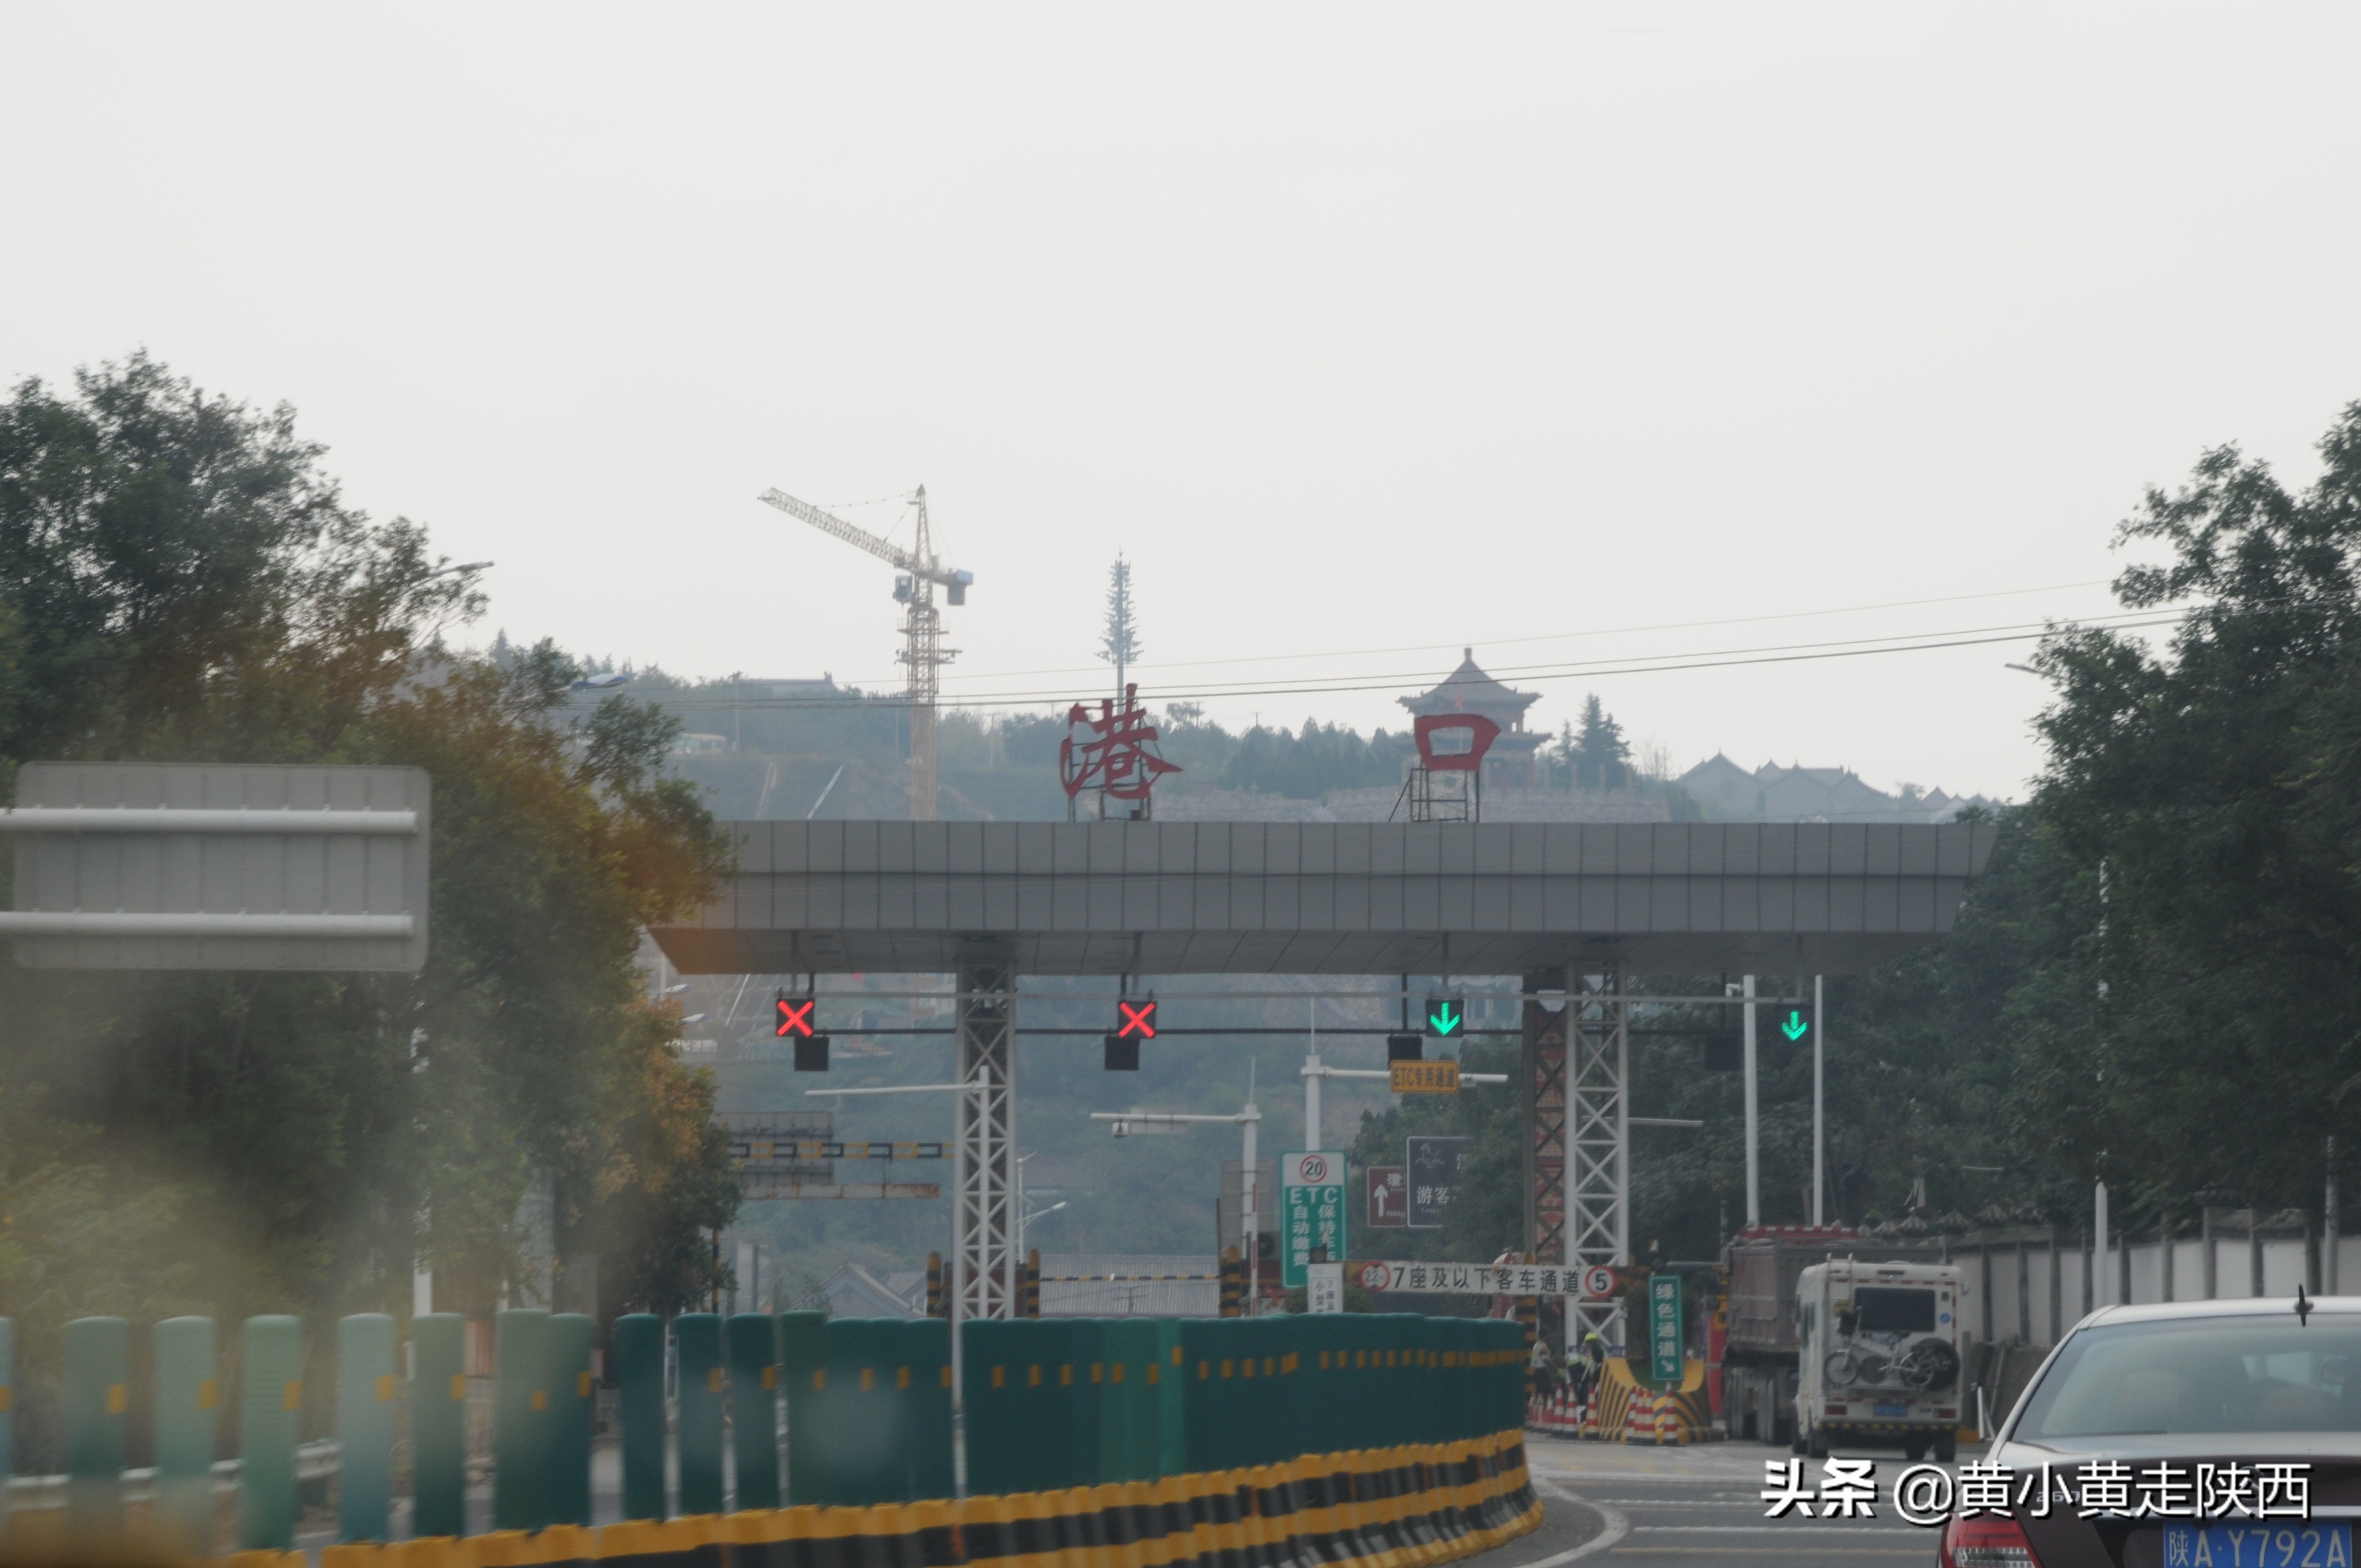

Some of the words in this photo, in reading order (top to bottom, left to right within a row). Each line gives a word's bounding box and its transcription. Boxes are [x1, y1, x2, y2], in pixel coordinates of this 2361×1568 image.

[1060, 683, 1502, 799] 港口
[1393, 1066, 1455, 1087] ETC专用通道
[1305, 1161, 1323, 1175] 20
[1291, 1188, 1337, 1204] ETC
[1417, 1186, 1458, 1205] 游客
[1393, 1267, 1579, 1293] 7座及以下客车通道
[1595, 1273, 1607, 1291] 5
[1656, 1284, 1676, 1356] 绿色通道
